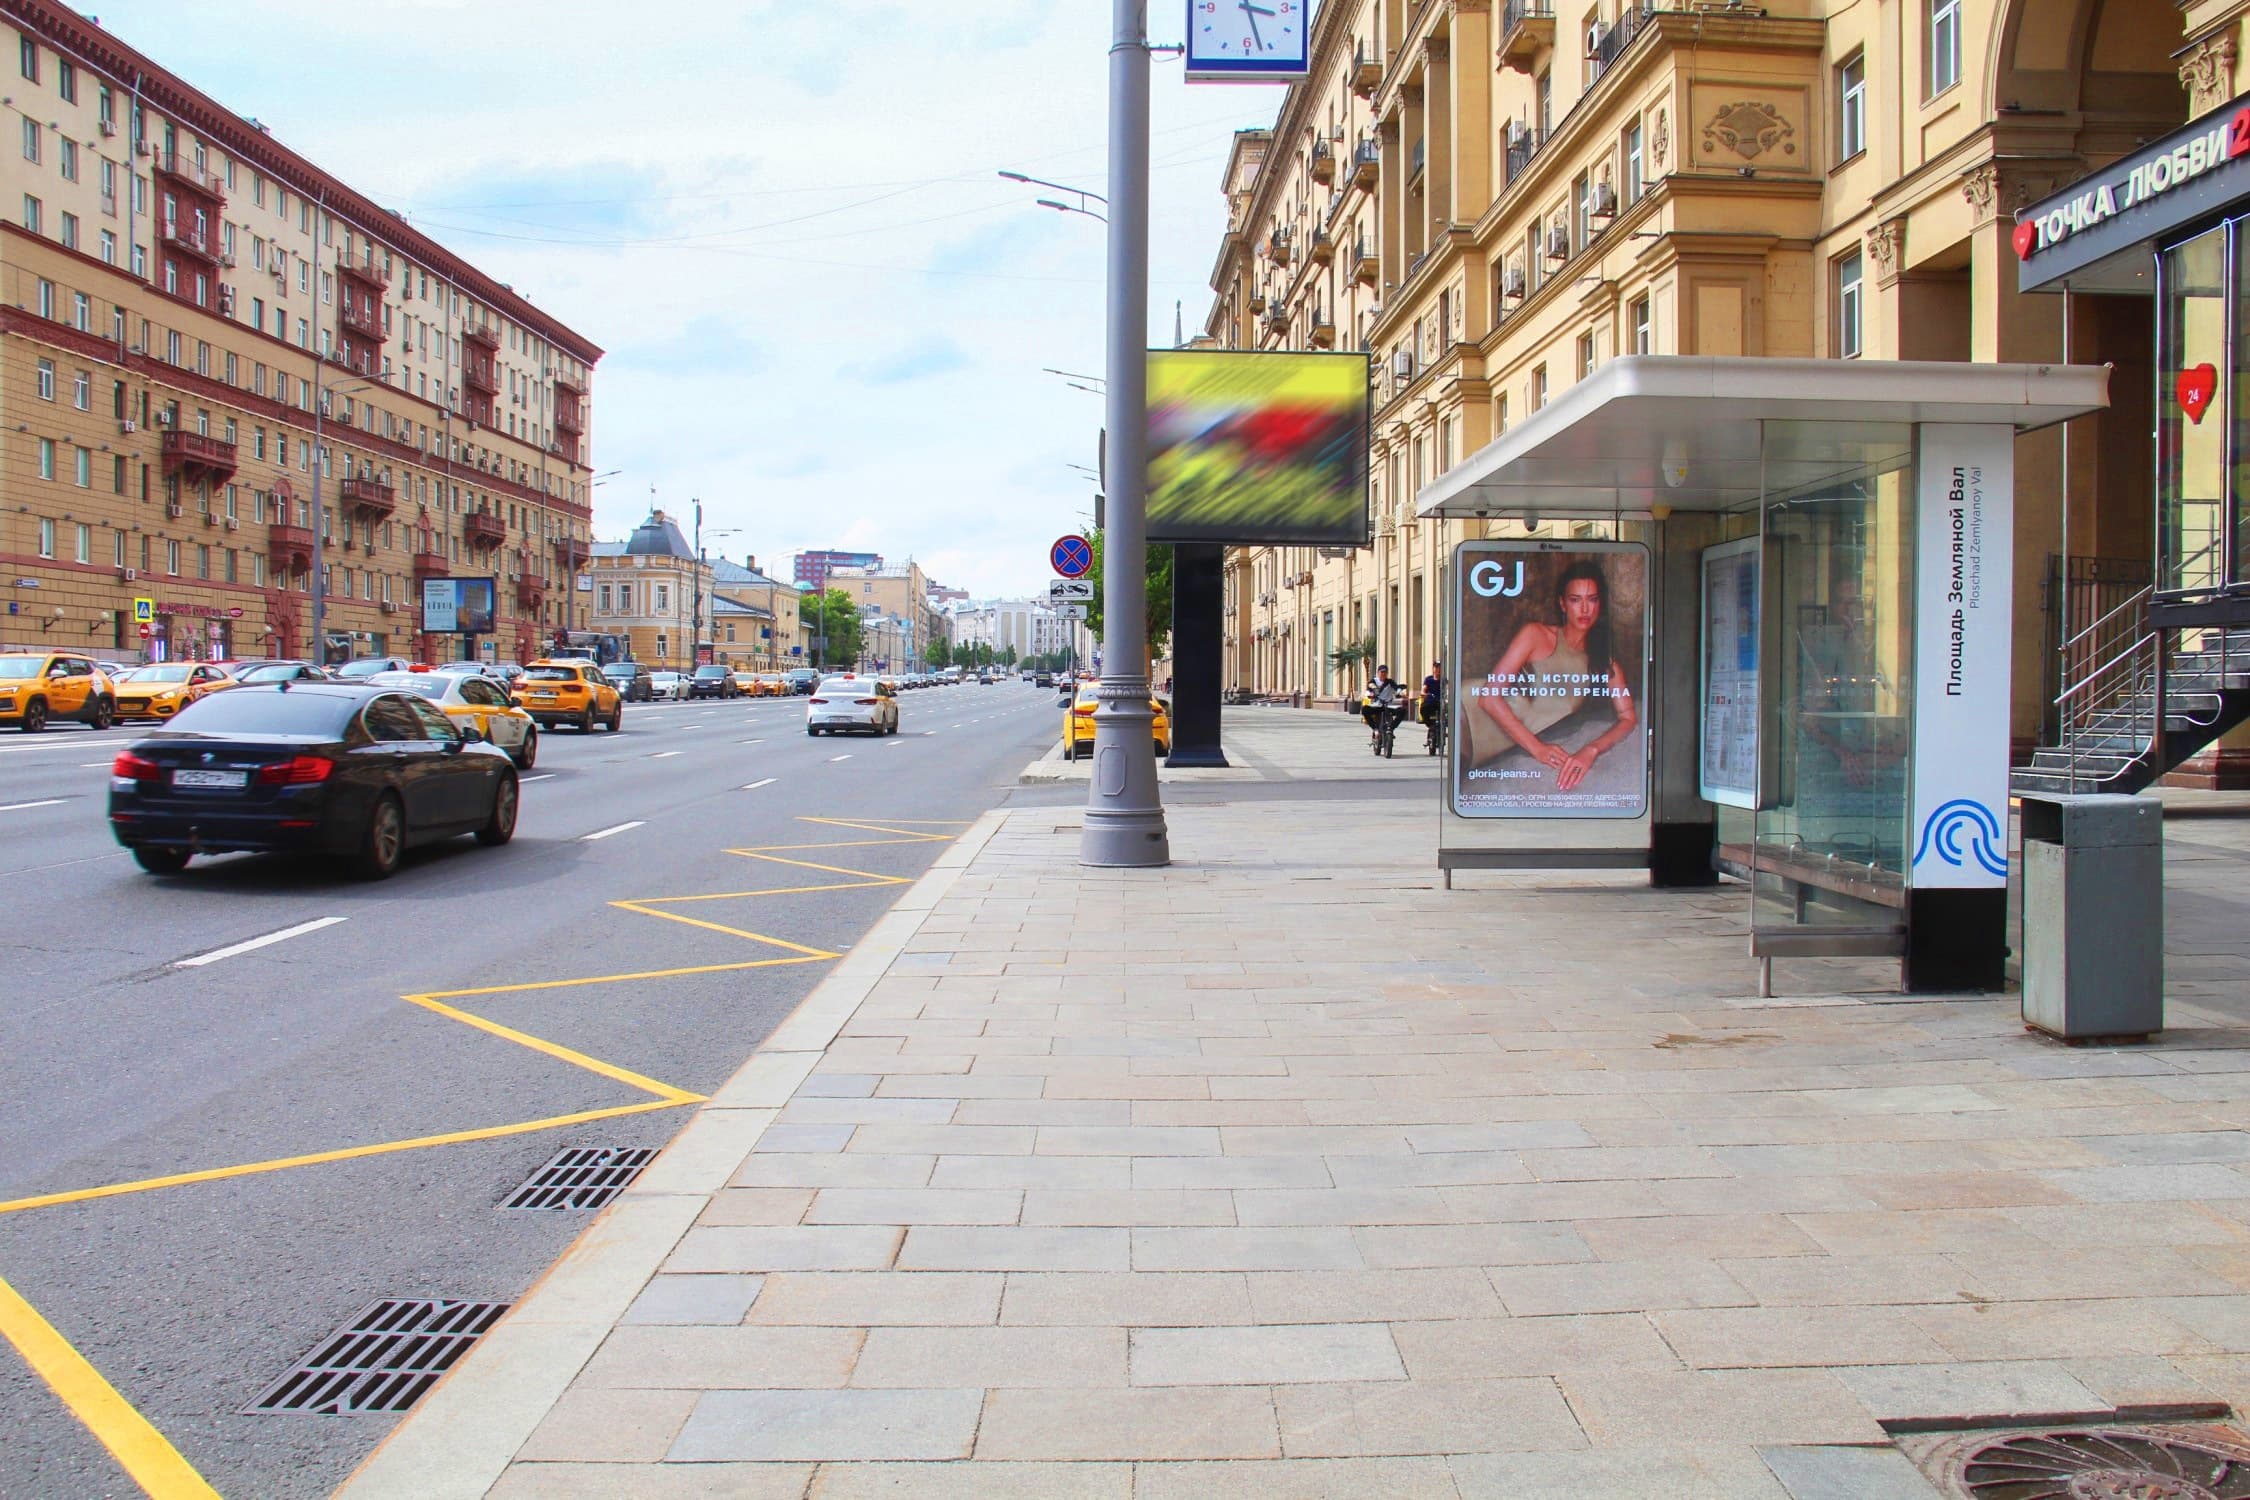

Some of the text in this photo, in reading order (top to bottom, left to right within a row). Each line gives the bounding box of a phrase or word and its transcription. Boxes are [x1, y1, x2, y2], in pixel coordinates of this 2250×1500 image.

[1206, 2, 1289, 13] 9 3
[1243, 37, 1251, 48] 6
[2034, 184, 2117, 249] ТОЧКА
[2124, 123, 2233, 207] ЛЮБВИ
[2187, 388, 2200, 404] 24
[1969, 467, 1983, 609] Ploschad Zemlyanoy Val
[1469, 560, 1525, 598] GJ
[1947, 466, 1966, 696] Площадь Земляной Вал
[1487, 672, 1610, 683] НОВАЯ ИСТОРИЯ
[1471, 686, 1632, 698] ИЗВЕСТНОГО БРЕНДА
[1468, 768, 1541, 780] gloria-jeans.ru
